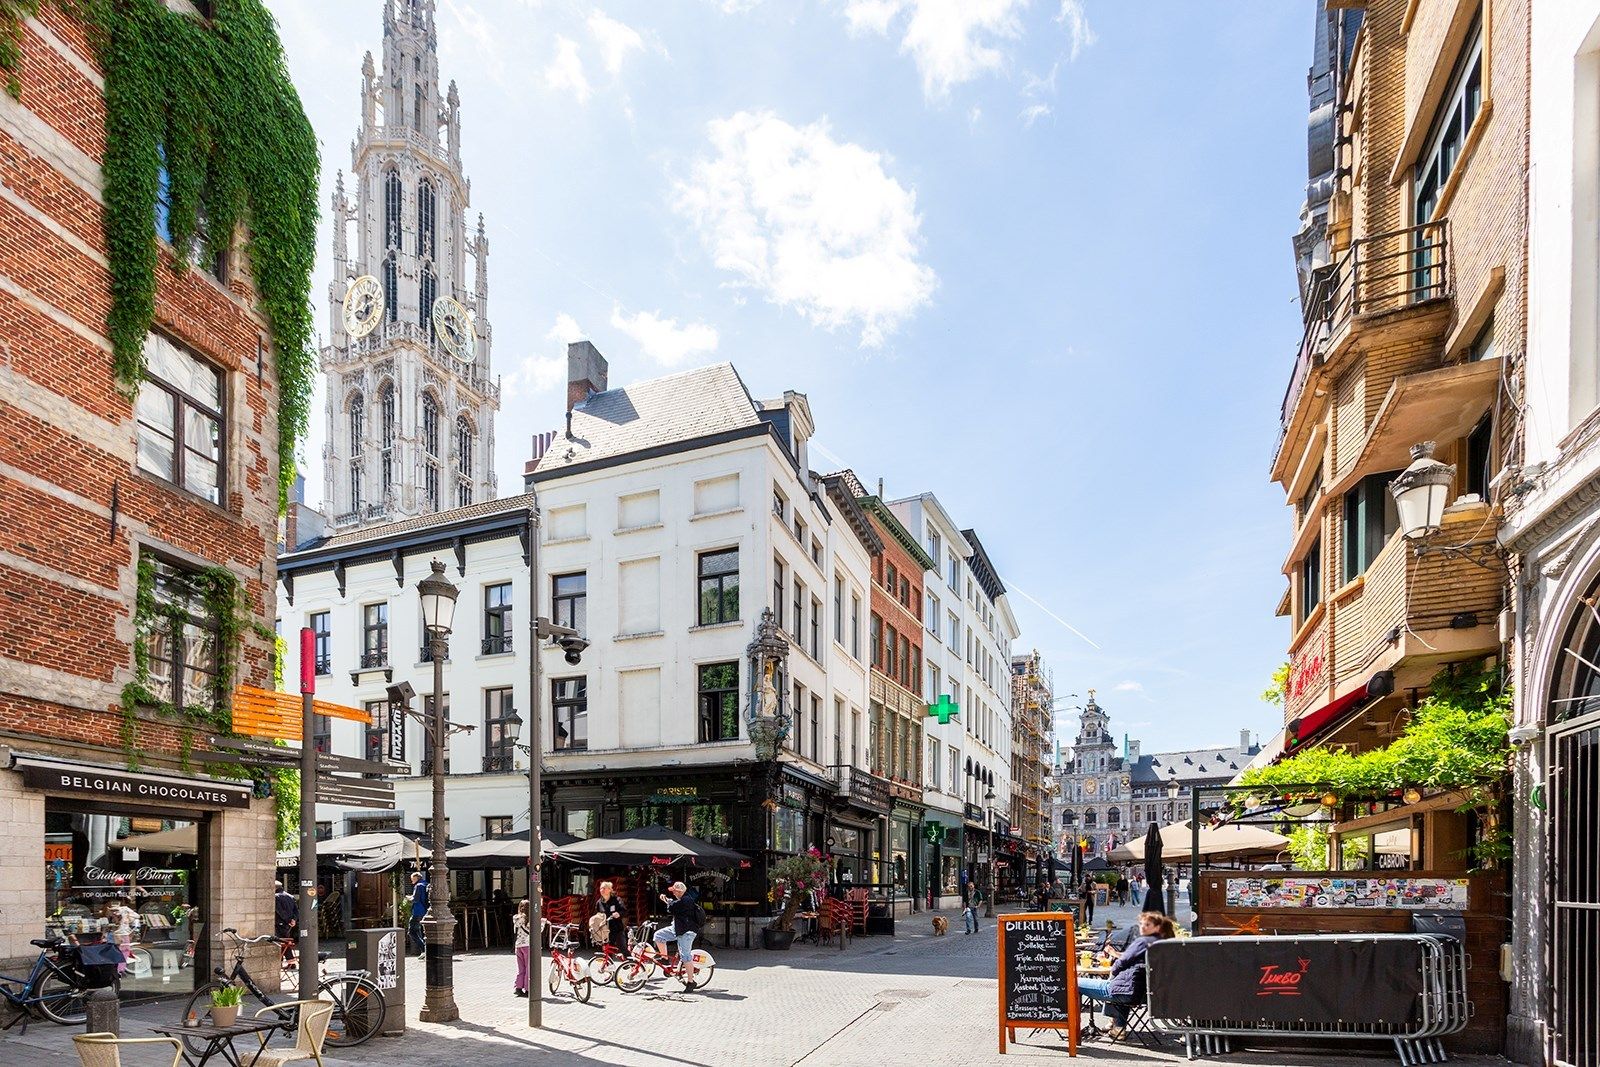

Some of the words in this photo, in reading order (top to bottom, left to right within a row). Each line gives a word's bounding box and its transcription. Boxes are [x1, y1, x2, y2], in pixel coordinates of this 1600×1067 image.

[61, 776, 132, 792] BELGIAN
[139, 784, 228, 802] CHOCOLATES
[1379, 854, 1405, 869] CABRON
[83, 866, 133, 881] Château
[136, 866, 173, 881] Blanc
[143, 889, 175, 897] CHOCOLATES
[1006, 921, 1044, 931] BIEREN
[1017, 941, 1046, 951] Bolleke
[1020, 973, 1055, 983] Karmeliet
